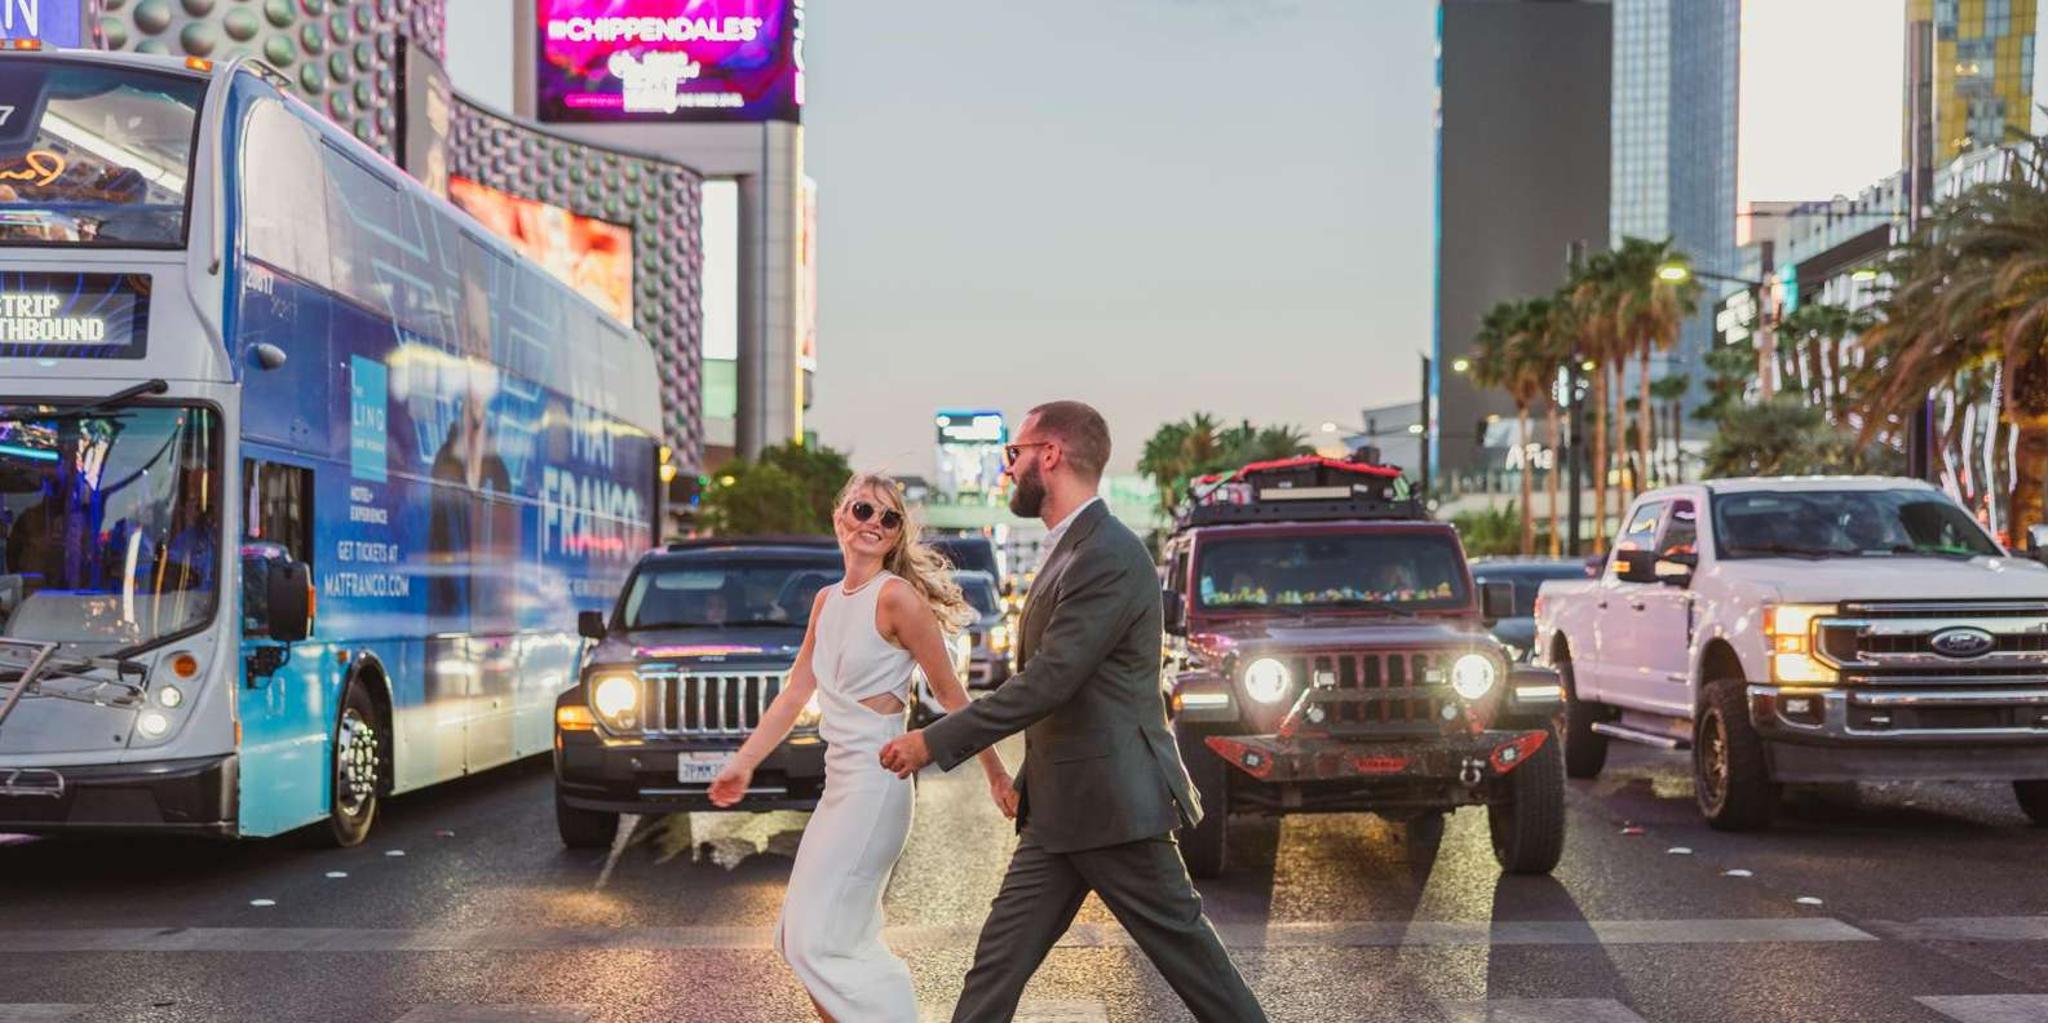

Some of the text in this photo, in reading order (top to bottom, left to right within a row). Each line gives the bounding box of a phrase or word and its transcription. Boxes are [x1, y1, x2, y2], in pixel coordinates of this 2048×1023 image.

[0, 294, 60, 318] TRIP
[543, 465, 639, 562] FRANCO
[338, 540, 399, 563] GET TICKETS AT
[324, 571, 410, 597] MATFRANCO.COM
